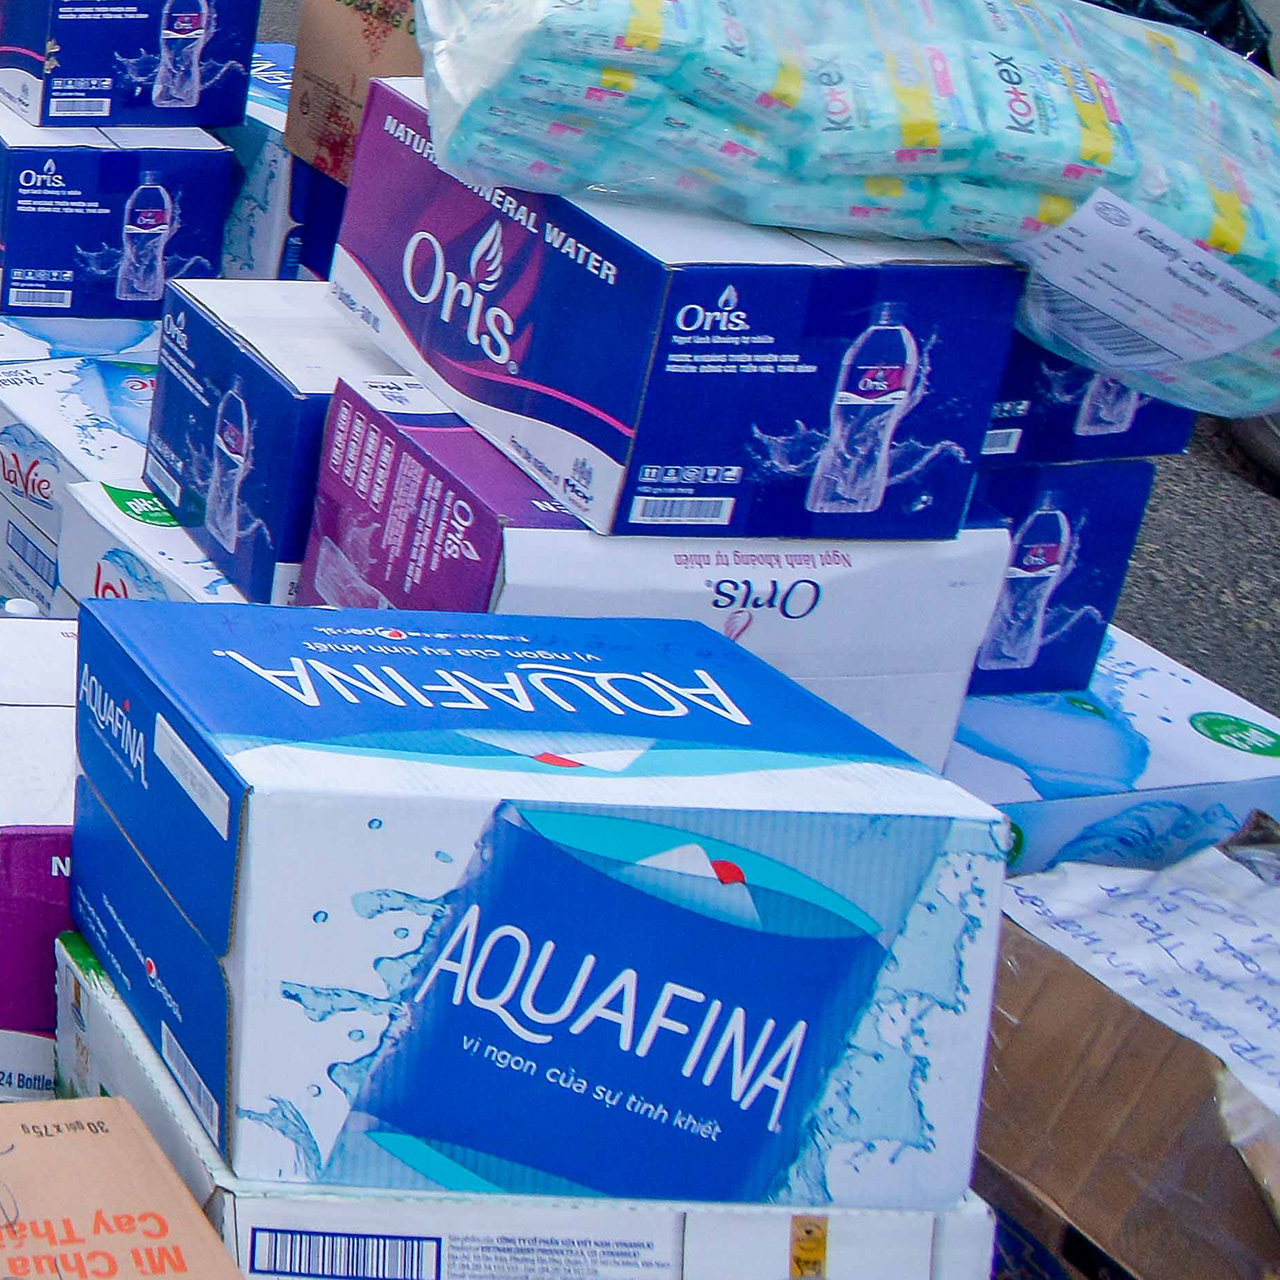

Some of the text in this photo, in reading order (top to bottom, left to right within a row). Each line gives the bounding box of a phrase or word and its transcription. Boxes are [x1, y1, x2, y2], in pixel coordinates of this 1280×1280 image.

[1004, 49, 1035, 137] kotex
[543, 224, 618, 287] WATER
[401, 230, 518, 375] Oris
[711, 578, 822, 620] Oris
[220, 650, 752, 727] AQUAFINA
[76, 661, 149, 788] AQUAFINA
[414, 903, 810, 1133] AQUAFINA
[17, 1072, 55, 1091] Bottle
[462, 1032, 724, 1143] vị ngon của sự tinh khiết
[87, 1120, 109, 1134] 30
[88, 1210, 169, 1239] Cay
[6, 1244, 189, 1280] Mì Chua
